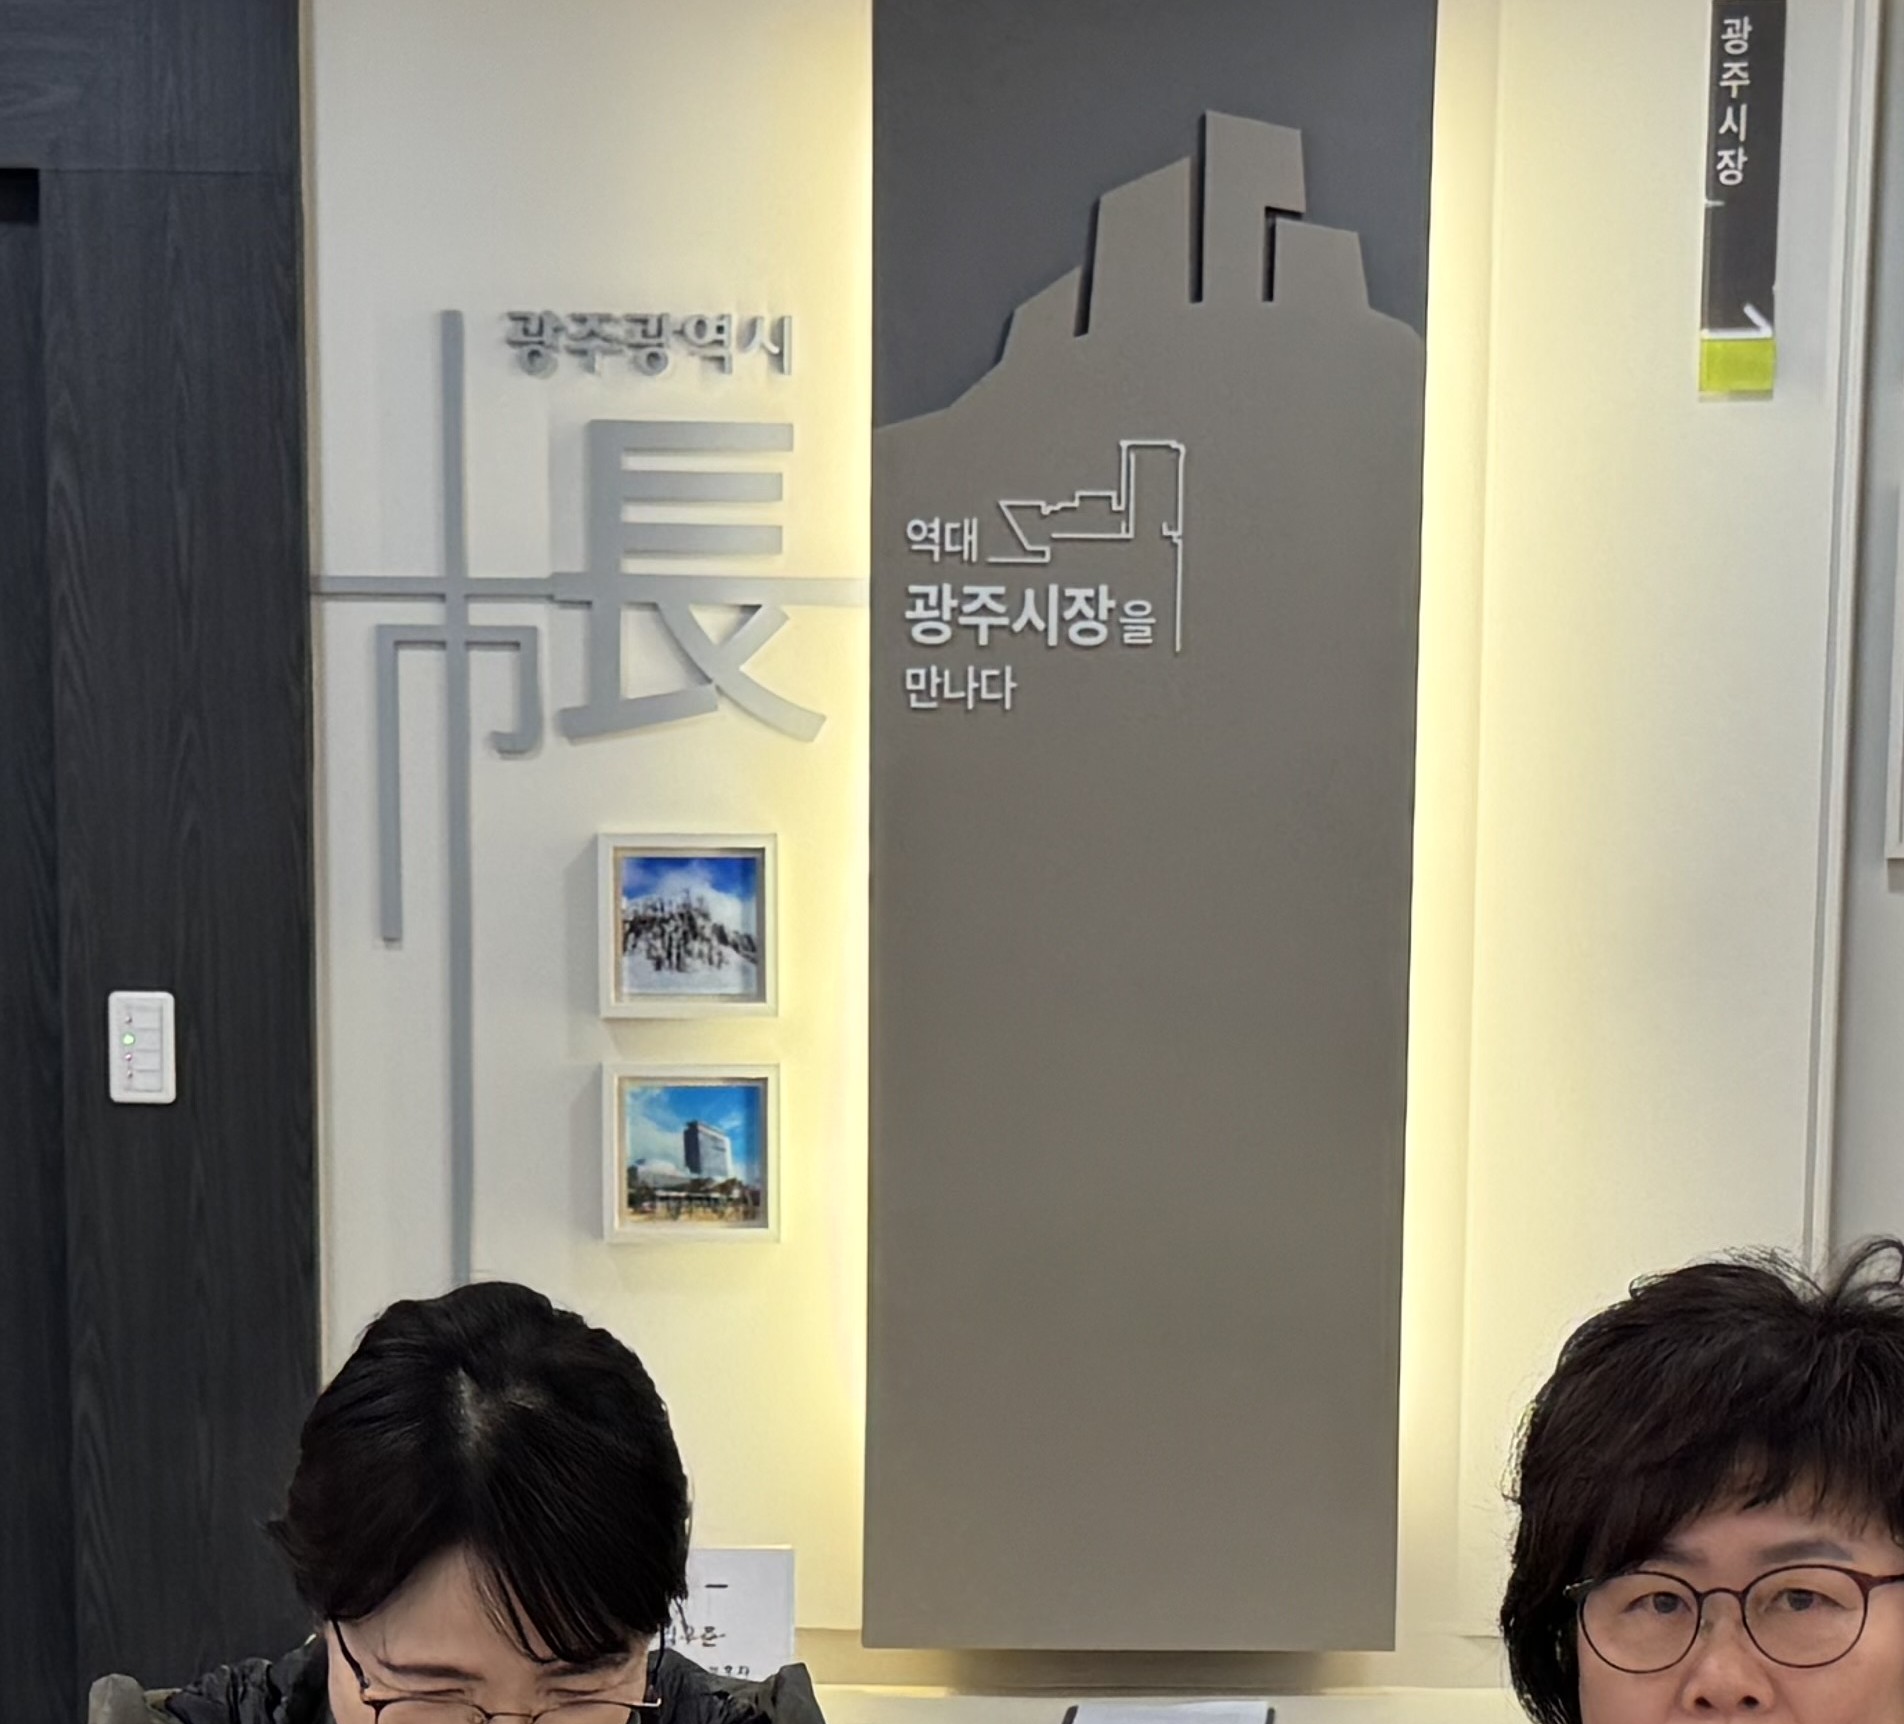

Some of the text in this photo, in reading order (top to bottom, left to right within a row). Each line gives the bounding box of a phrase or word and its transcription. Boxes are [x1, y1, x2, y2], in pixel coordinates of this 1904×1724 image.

[1716, 16, 1754, 187] 광주시장
[505, 310, 793, 376] 광주광역시
[906, 516, 979, 563] 역대
[904, 582, 1157, 647] 광주시장을
[904, 664, 1019, 711] 만나다
